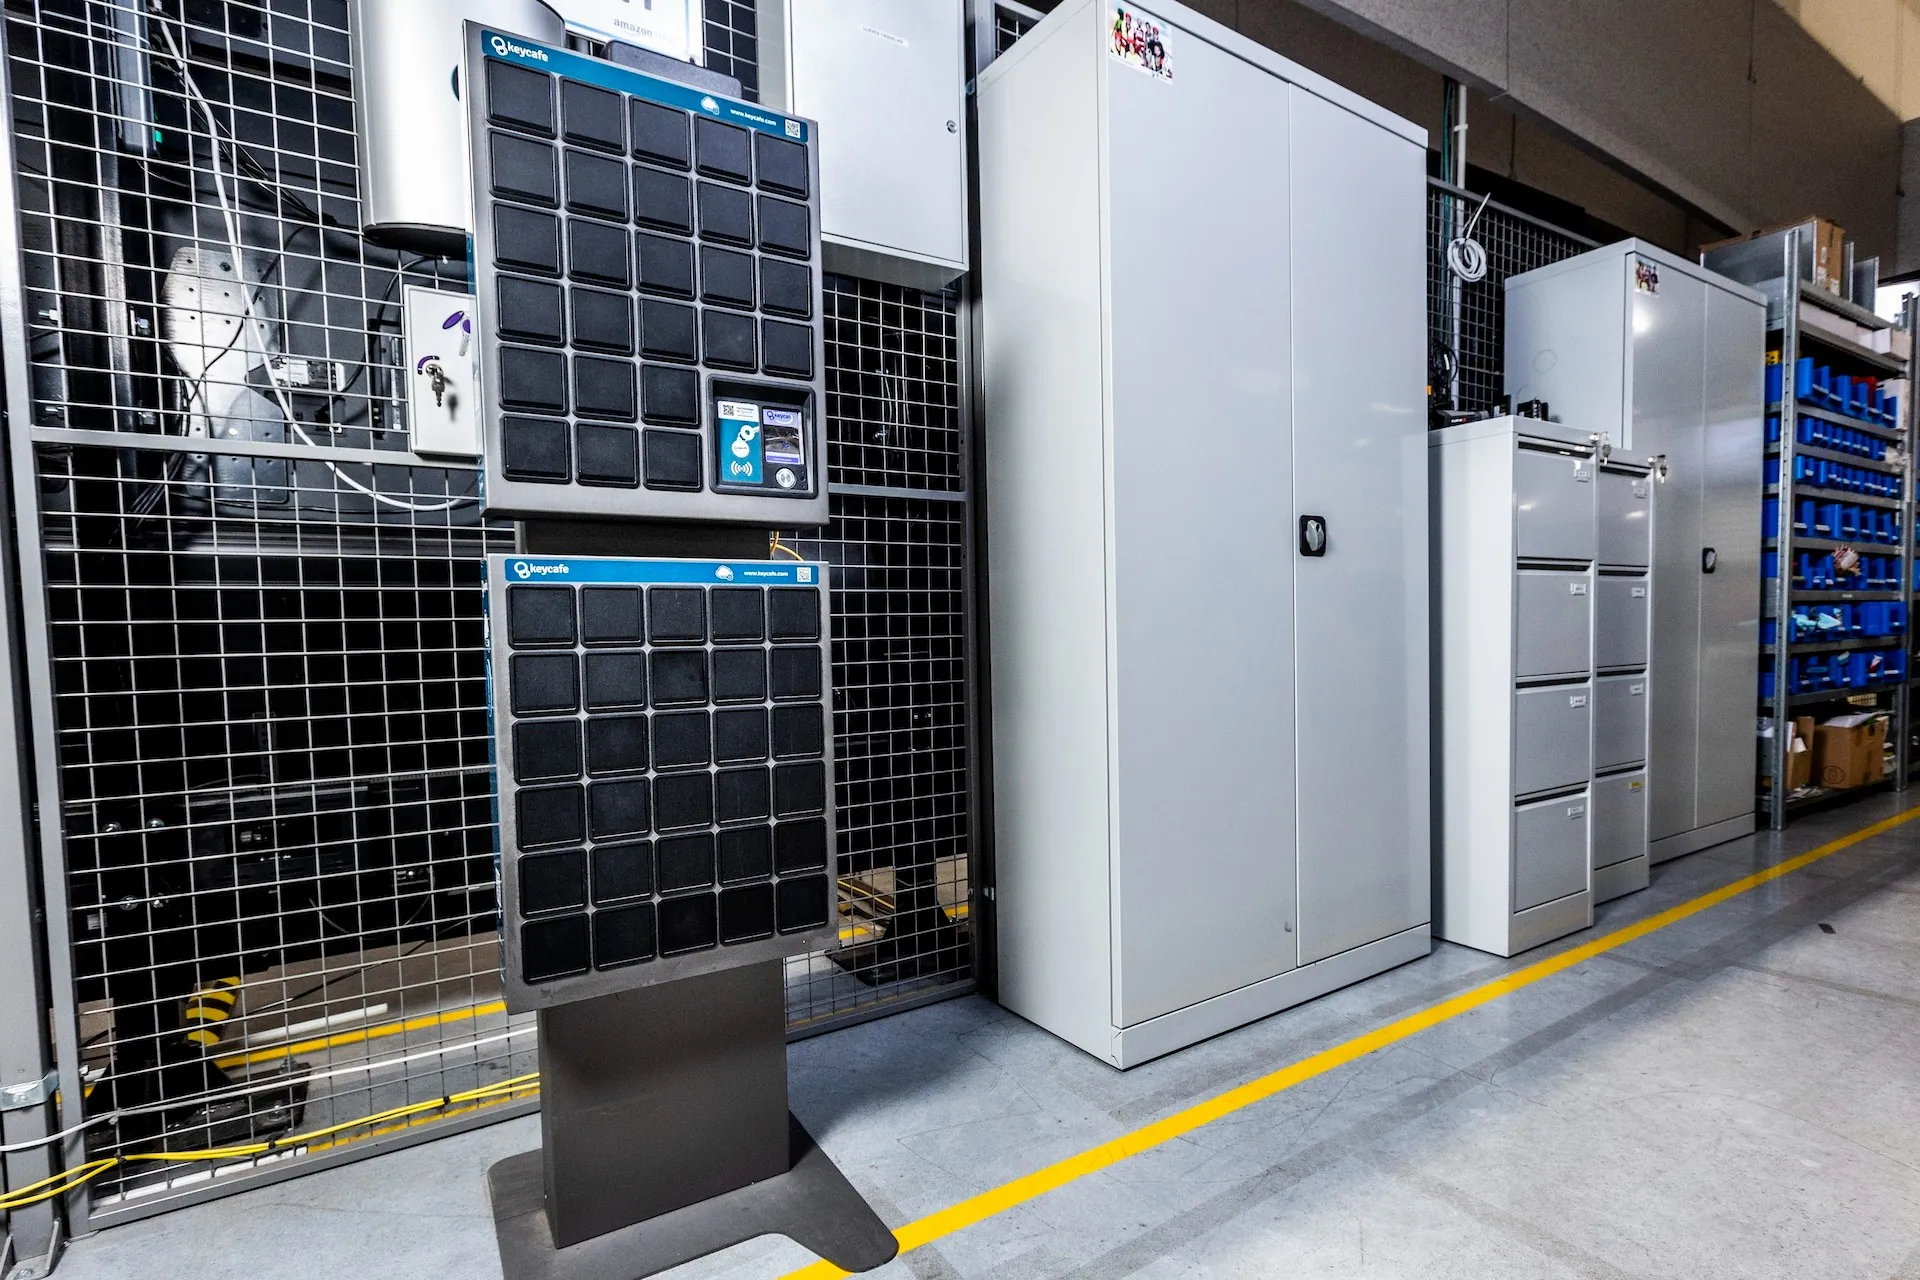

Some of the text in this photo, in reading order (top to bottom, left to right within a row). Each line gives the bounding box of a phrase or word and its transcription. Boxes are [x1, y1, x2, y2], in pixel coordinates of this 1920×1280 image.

[613, 18, 653, 37] amazon
[507, 41, 549, 62] keycafe
[729, 108, 777, 127] www.keycafe.com
[529, 562, 569, 576] keycafe
